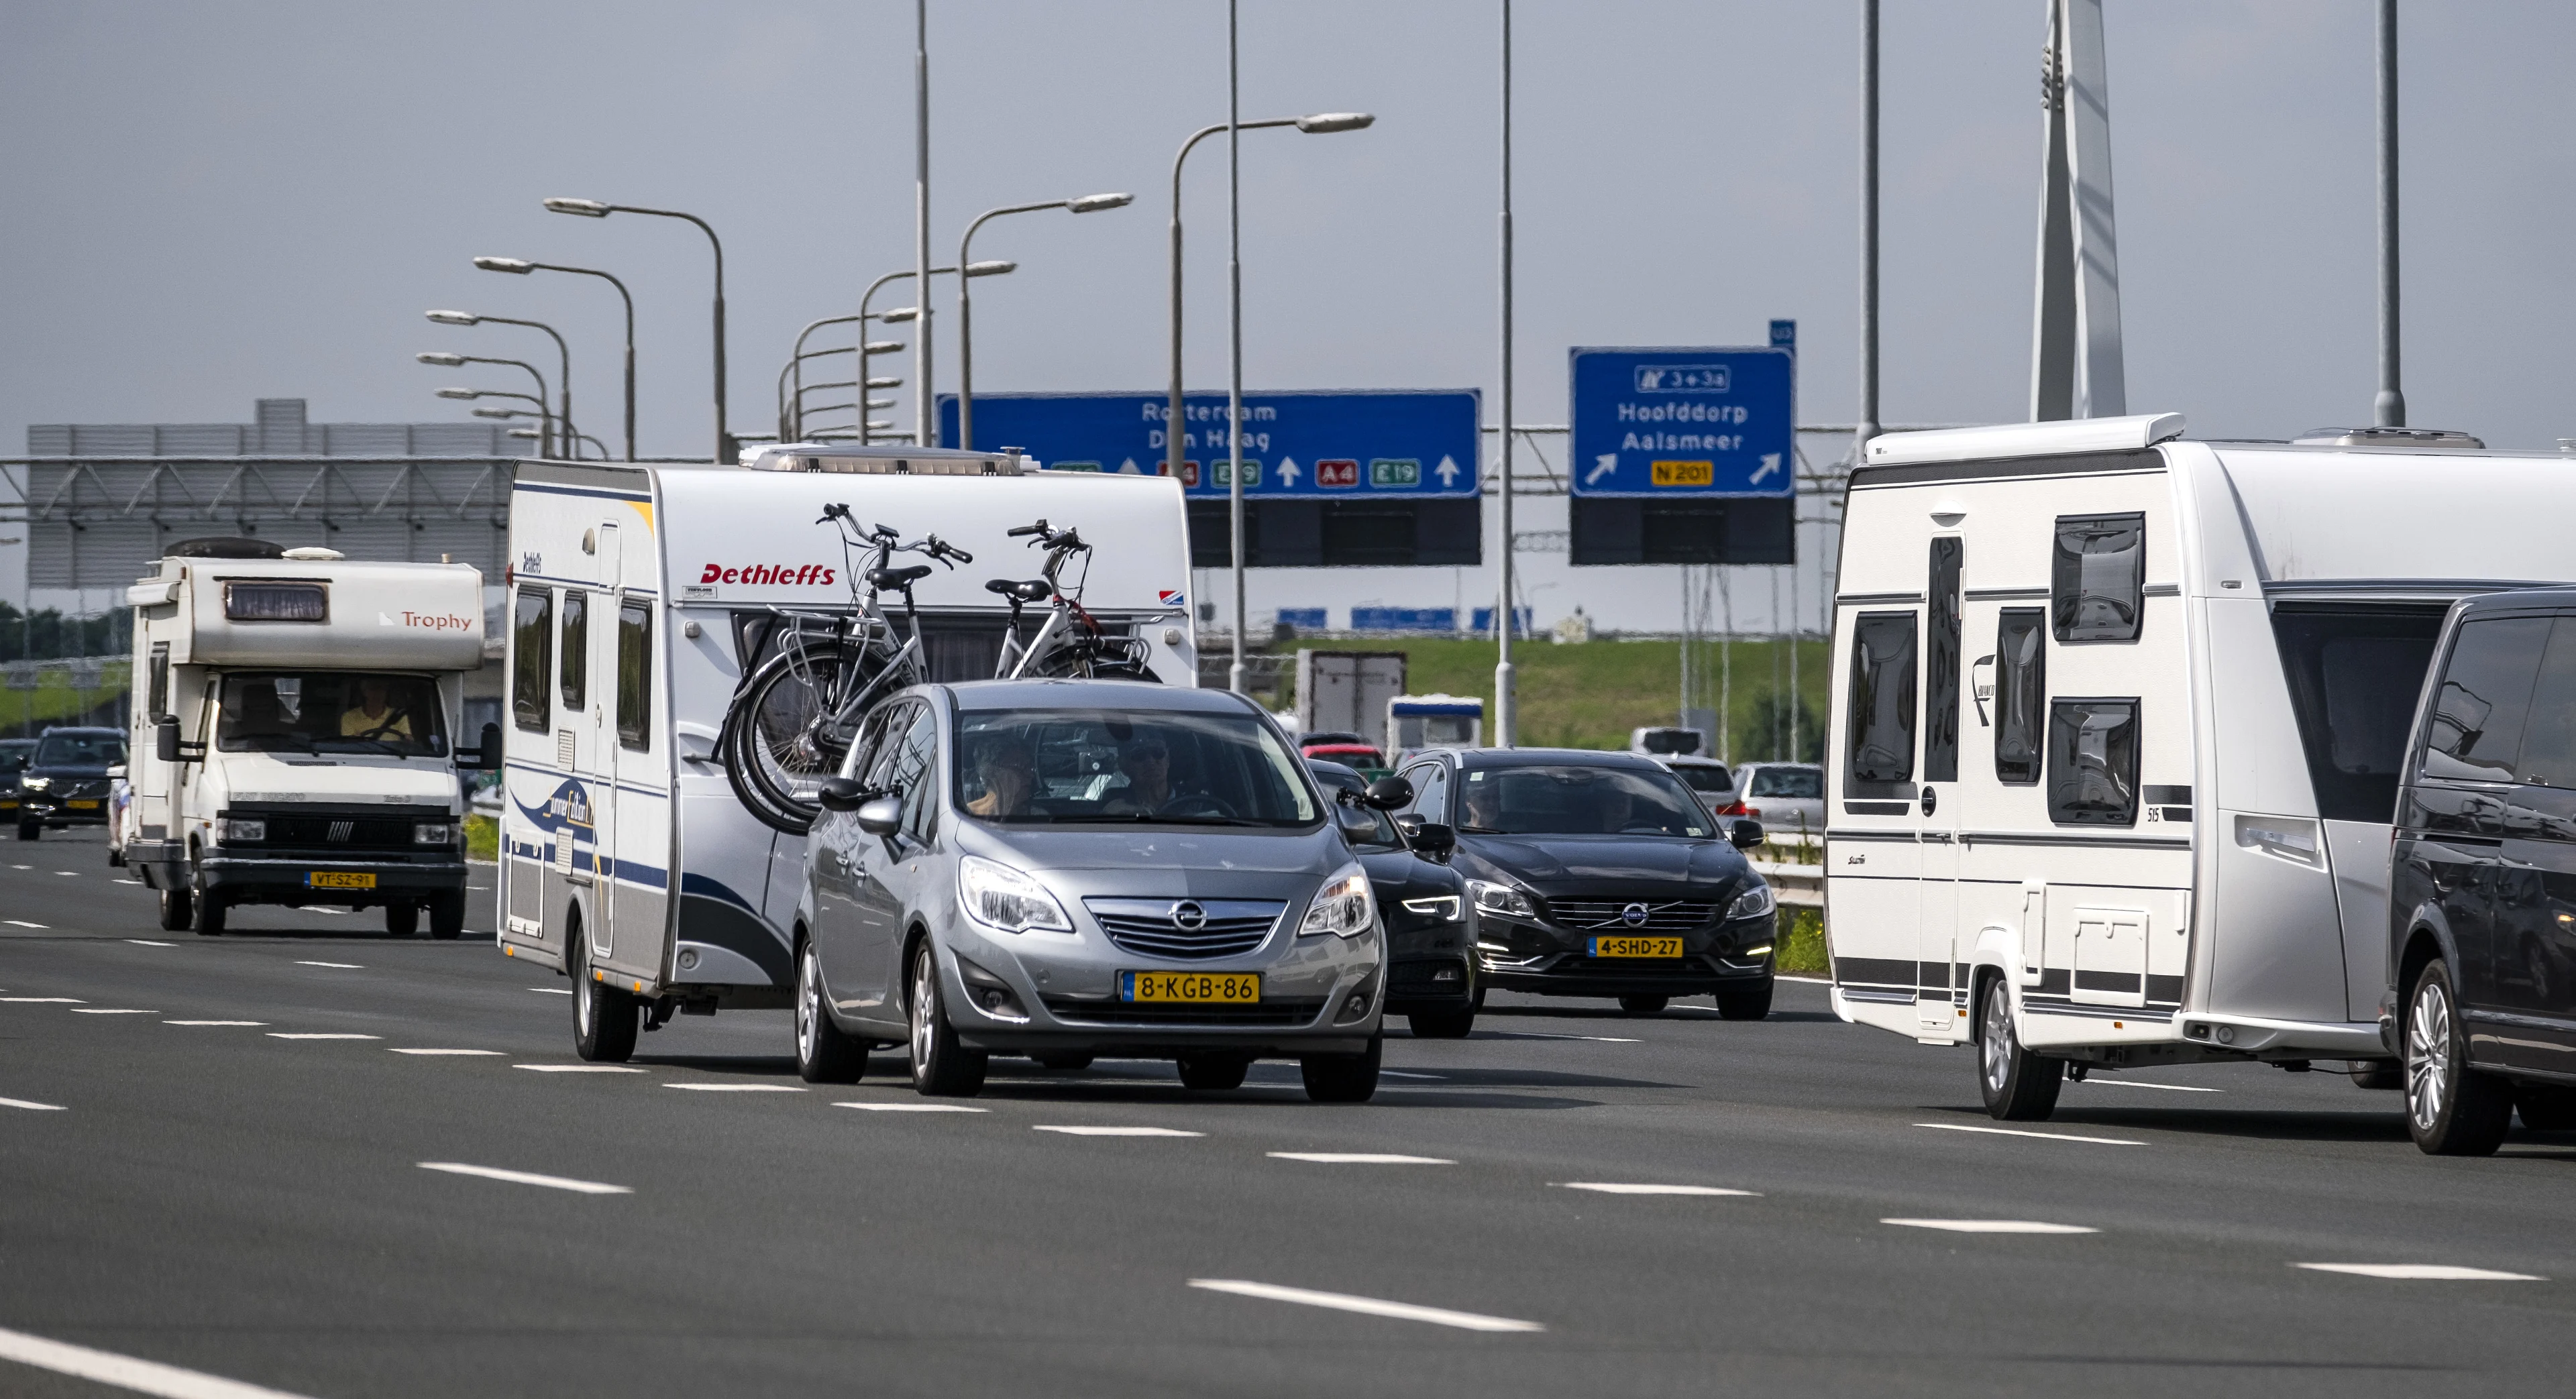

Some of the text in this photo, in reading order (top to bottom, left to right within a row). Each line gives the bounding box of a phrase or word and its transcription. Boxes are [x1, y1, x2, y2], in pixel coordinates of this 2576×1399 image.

[1142, 402, 1277, 422] Roteram
[1618, 401, 1748, 425] Hoofddorp
[1148, 429, 1271, 453] Dn Hag
[1621, 431, 1743, 451] Aalsmeer
[1218, 465, 1256, 482] E9
[700, 563, 836, 585] Dethleffs
[401, 611, 472, 631] Trophy
[2148, 807, 2159, 822] 515
[1601, 939, 1678, 954] 4-SHD-27
[1141, 976, 1253, 999] 8-KGB-86
